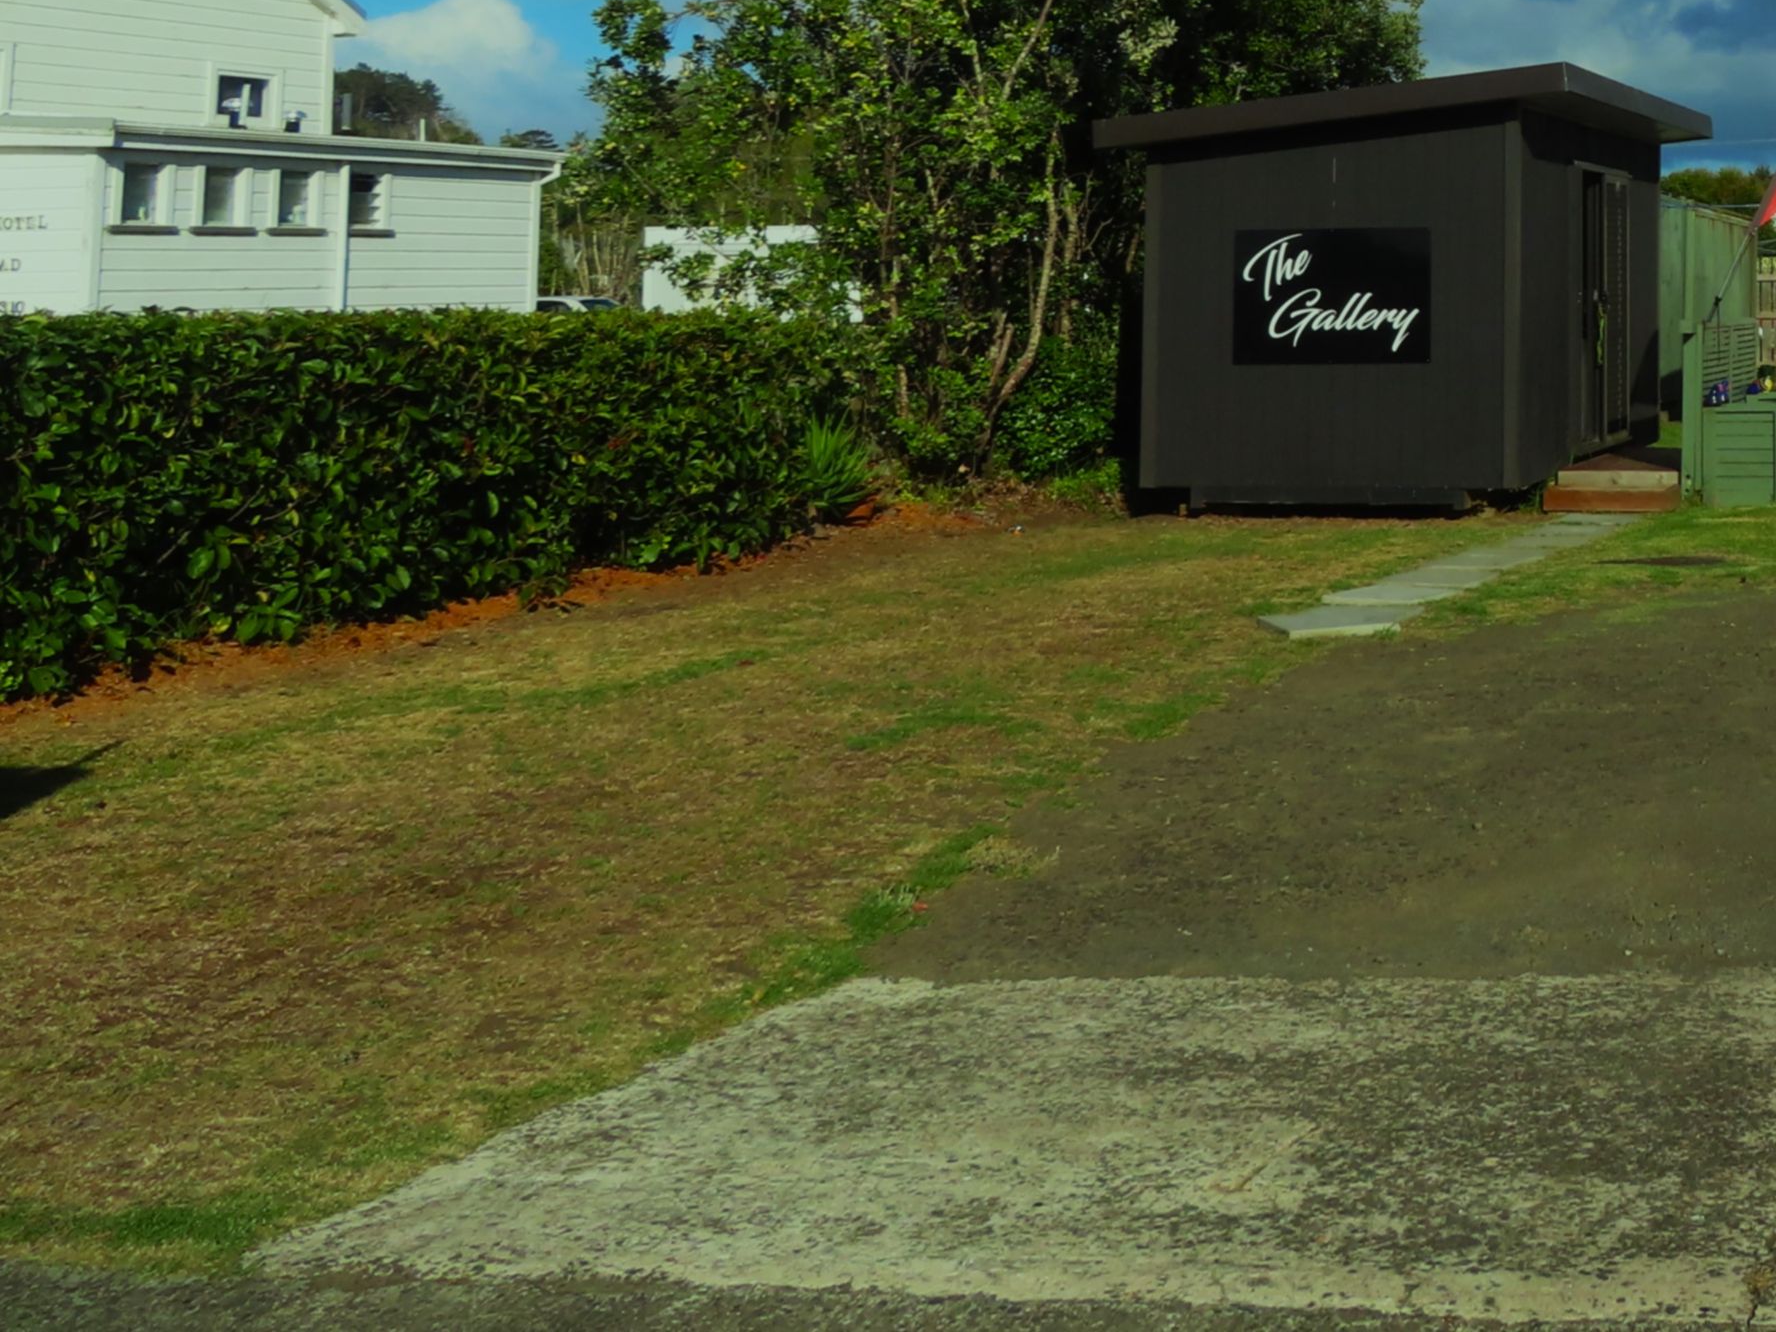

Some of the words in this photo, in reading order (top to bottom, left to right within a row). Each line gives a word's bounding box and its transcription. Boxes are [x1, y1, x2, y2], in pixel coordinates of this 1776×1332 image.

[0, 215, 47, 230] OTEL
[1242, 233, 1313, 302] The
[1268, 288, 1420, 352] Gallery
